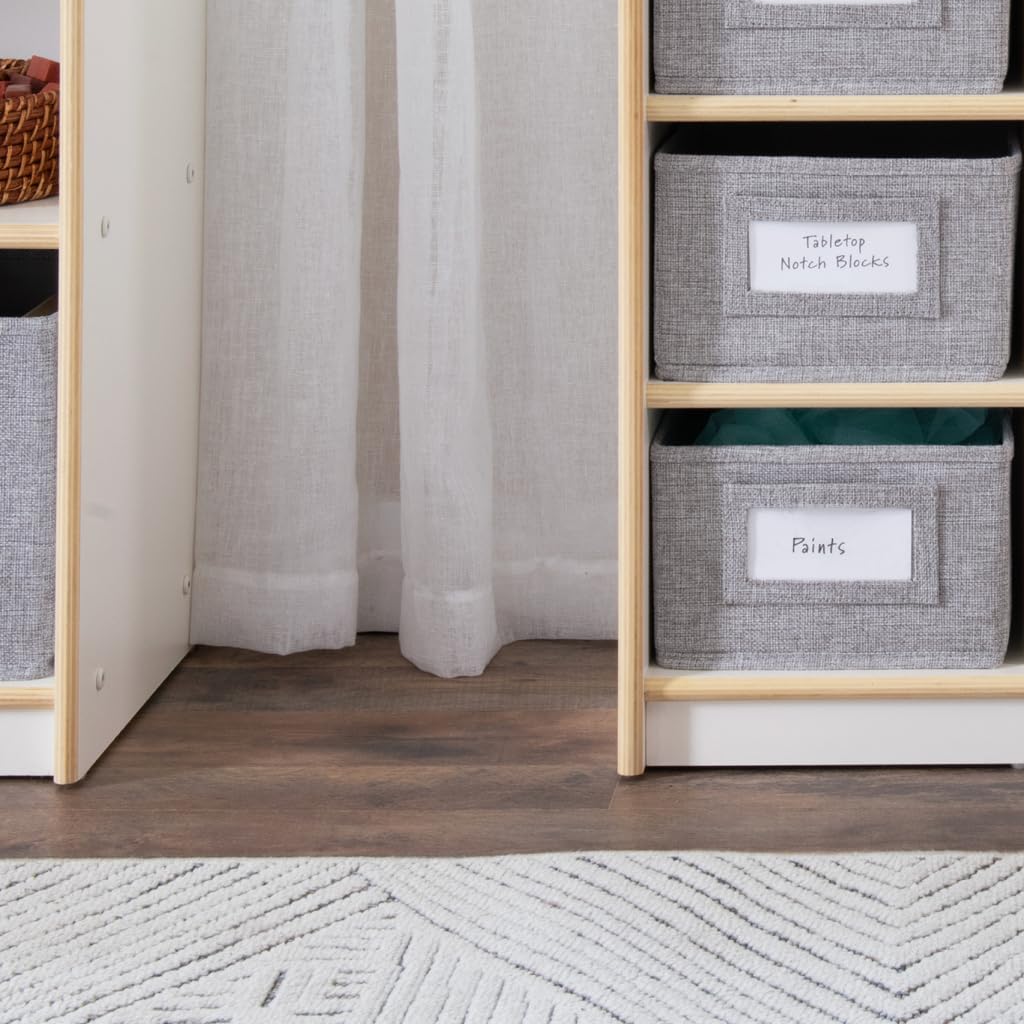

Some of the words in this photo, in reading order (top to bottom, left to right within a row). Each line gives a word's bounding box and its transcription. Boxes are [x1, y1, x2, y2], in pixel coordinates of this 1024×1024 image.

[802, 233, 867, 254] Tabletop
[780, 256, 826, 270] Notch
[835, 254, 891, 269] Blocks
[792, 537, 846, 556] Paints
